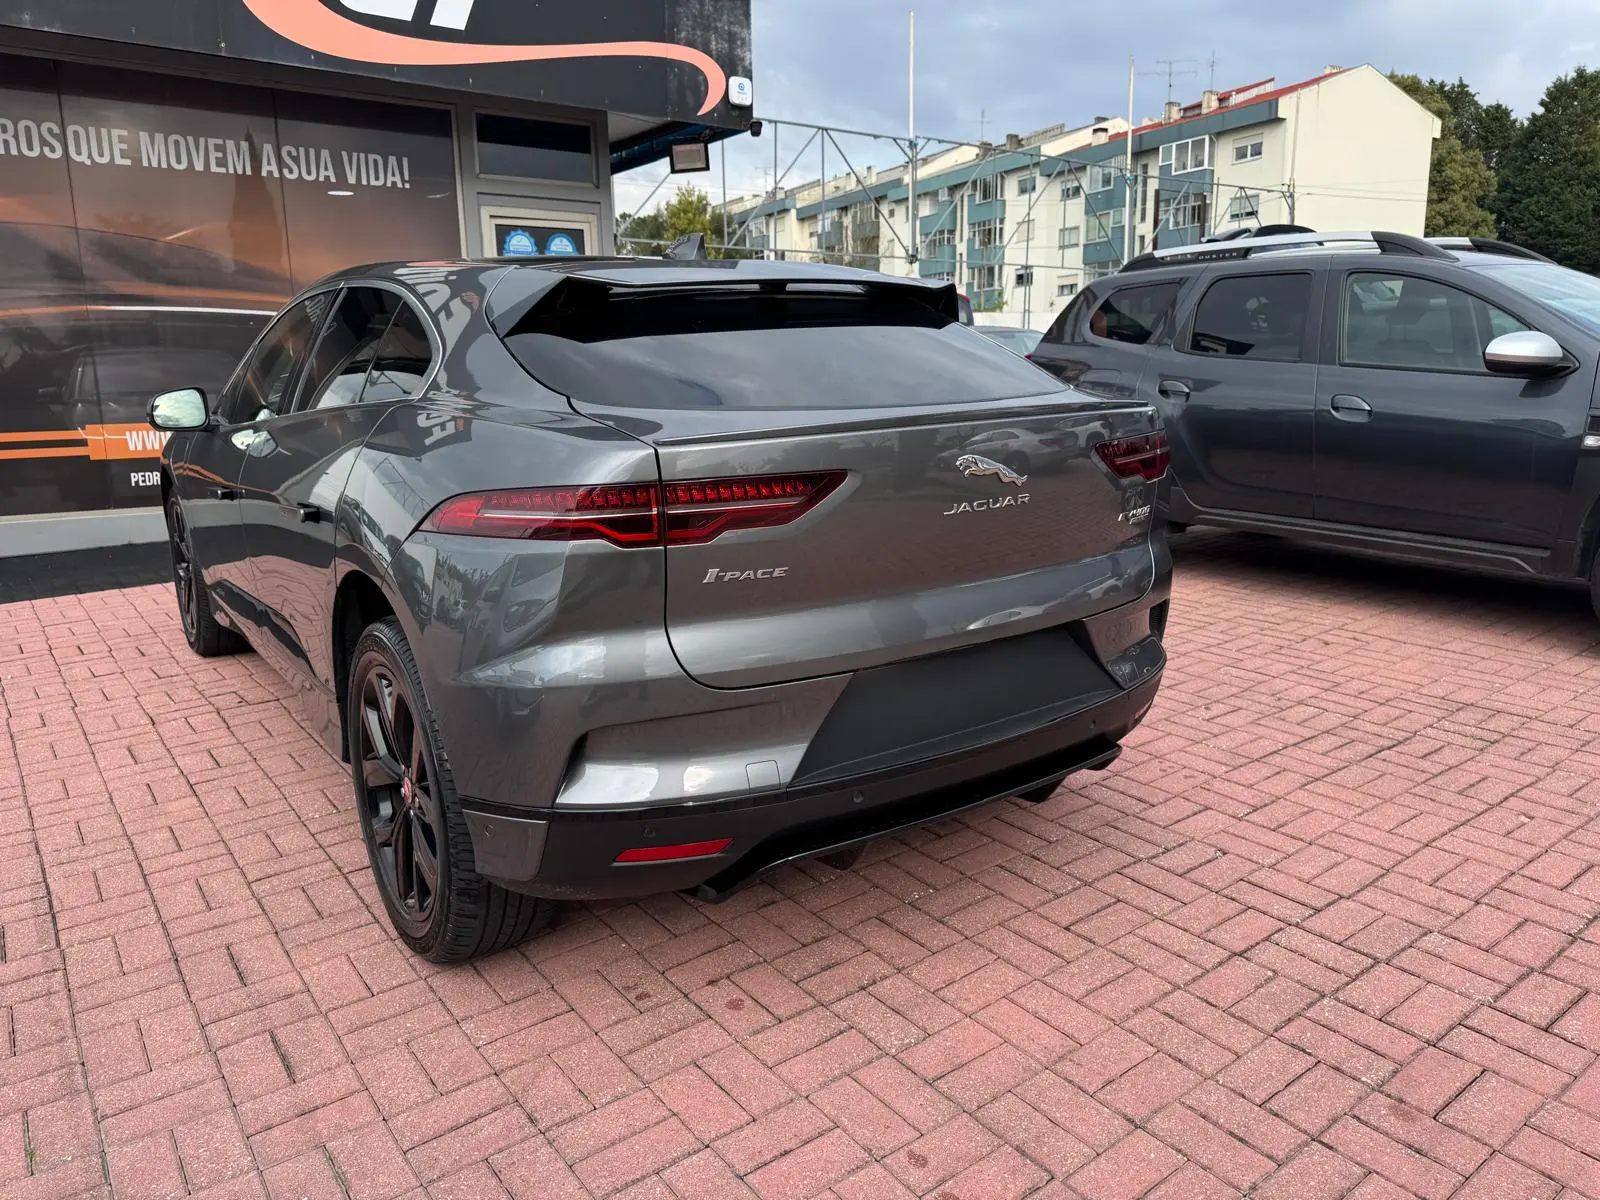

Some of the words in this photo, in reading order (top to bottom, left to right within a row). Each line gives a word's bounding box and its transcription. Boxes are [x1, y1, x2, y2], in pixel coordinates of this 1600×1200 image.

[138, 131, 252, 176] MOVEM
[341, 150, 411, 189] VIDA!
[943, 493, 1031, 515] JAGUAR
[702, 566, 790, 584] I-PACE
